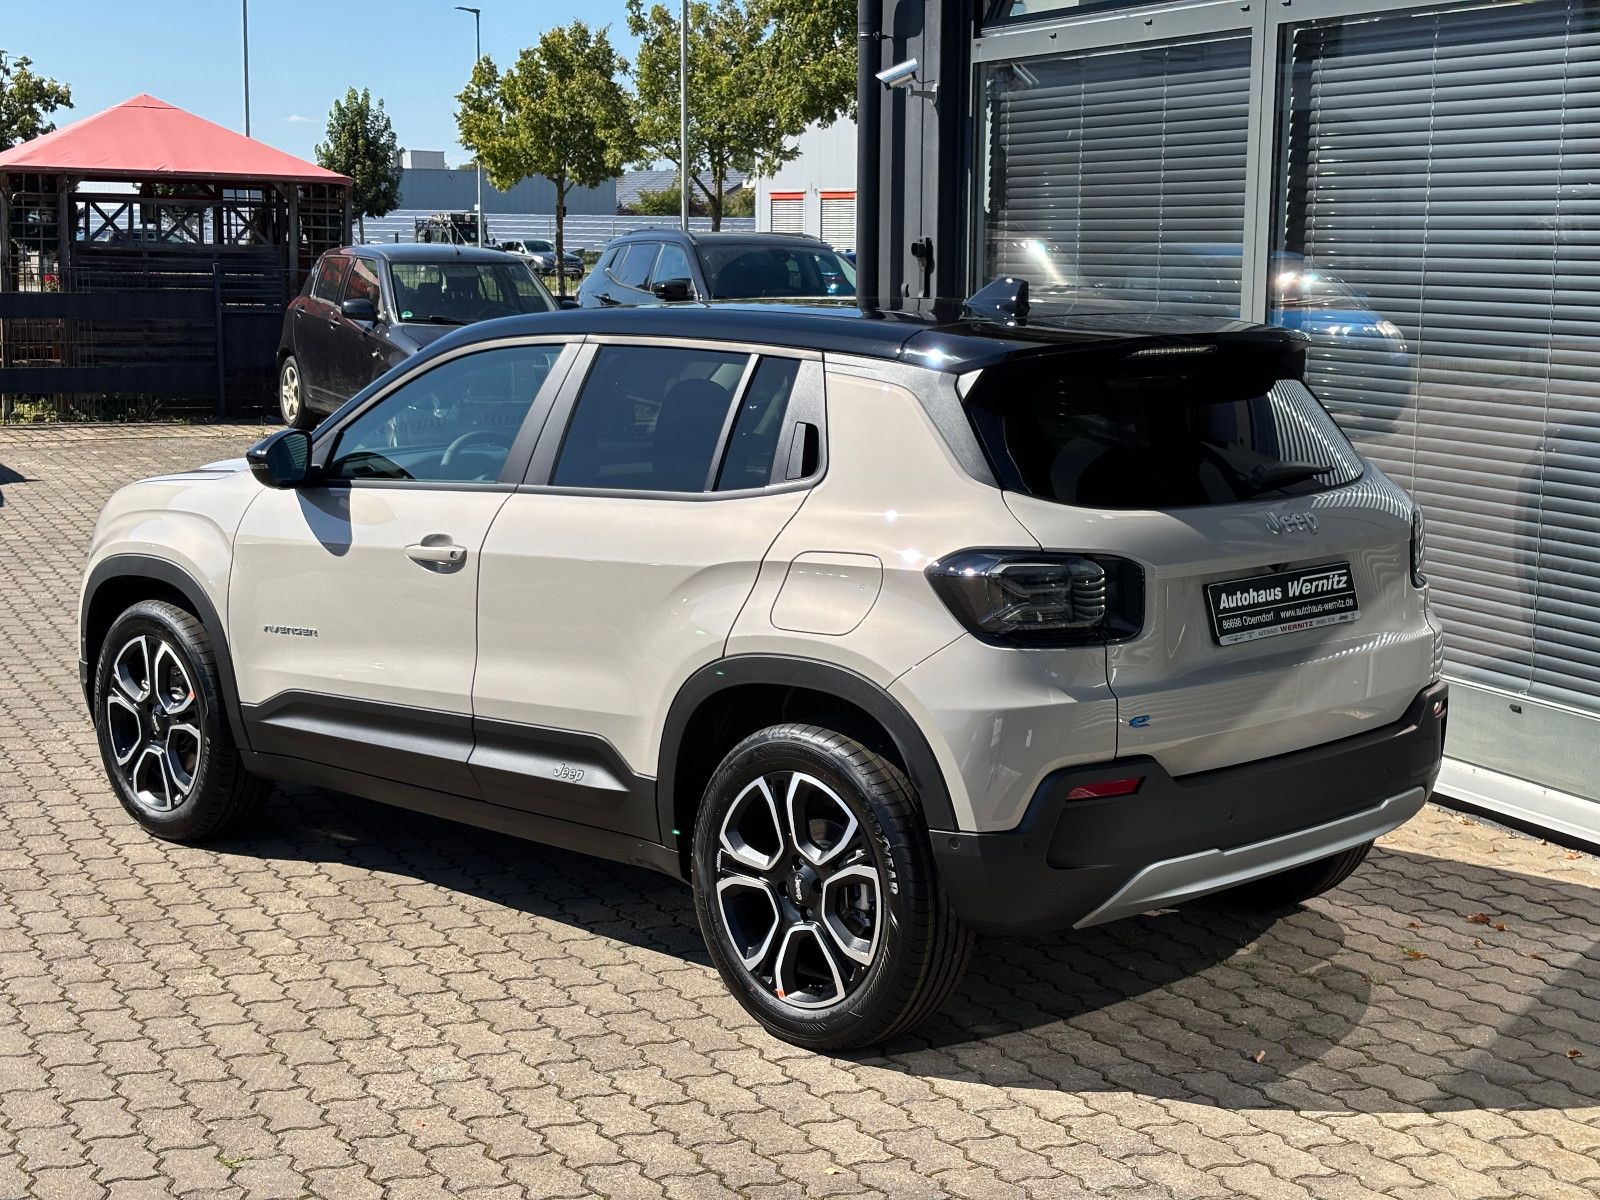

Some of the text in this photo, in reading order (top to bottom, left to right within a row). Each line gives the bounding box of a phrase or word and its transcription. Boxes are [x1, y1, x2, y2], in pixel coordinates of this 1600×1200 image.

[1265, 511, 1320, 536] Jeep
[1220, 570, 1347, 609] Autohaus Wernitz
[1222, 617, 1242, 629] 86698
[1243, 611, 1274, 625] Oberndorf
[1280, 598, 1353, 618] www.autohaus-wernitz.de
[264, 625, 318, 637] AVENGER
[1280, 621, 1314, 632] WERNITZ
[553, 763, 584, 783] Jeep
